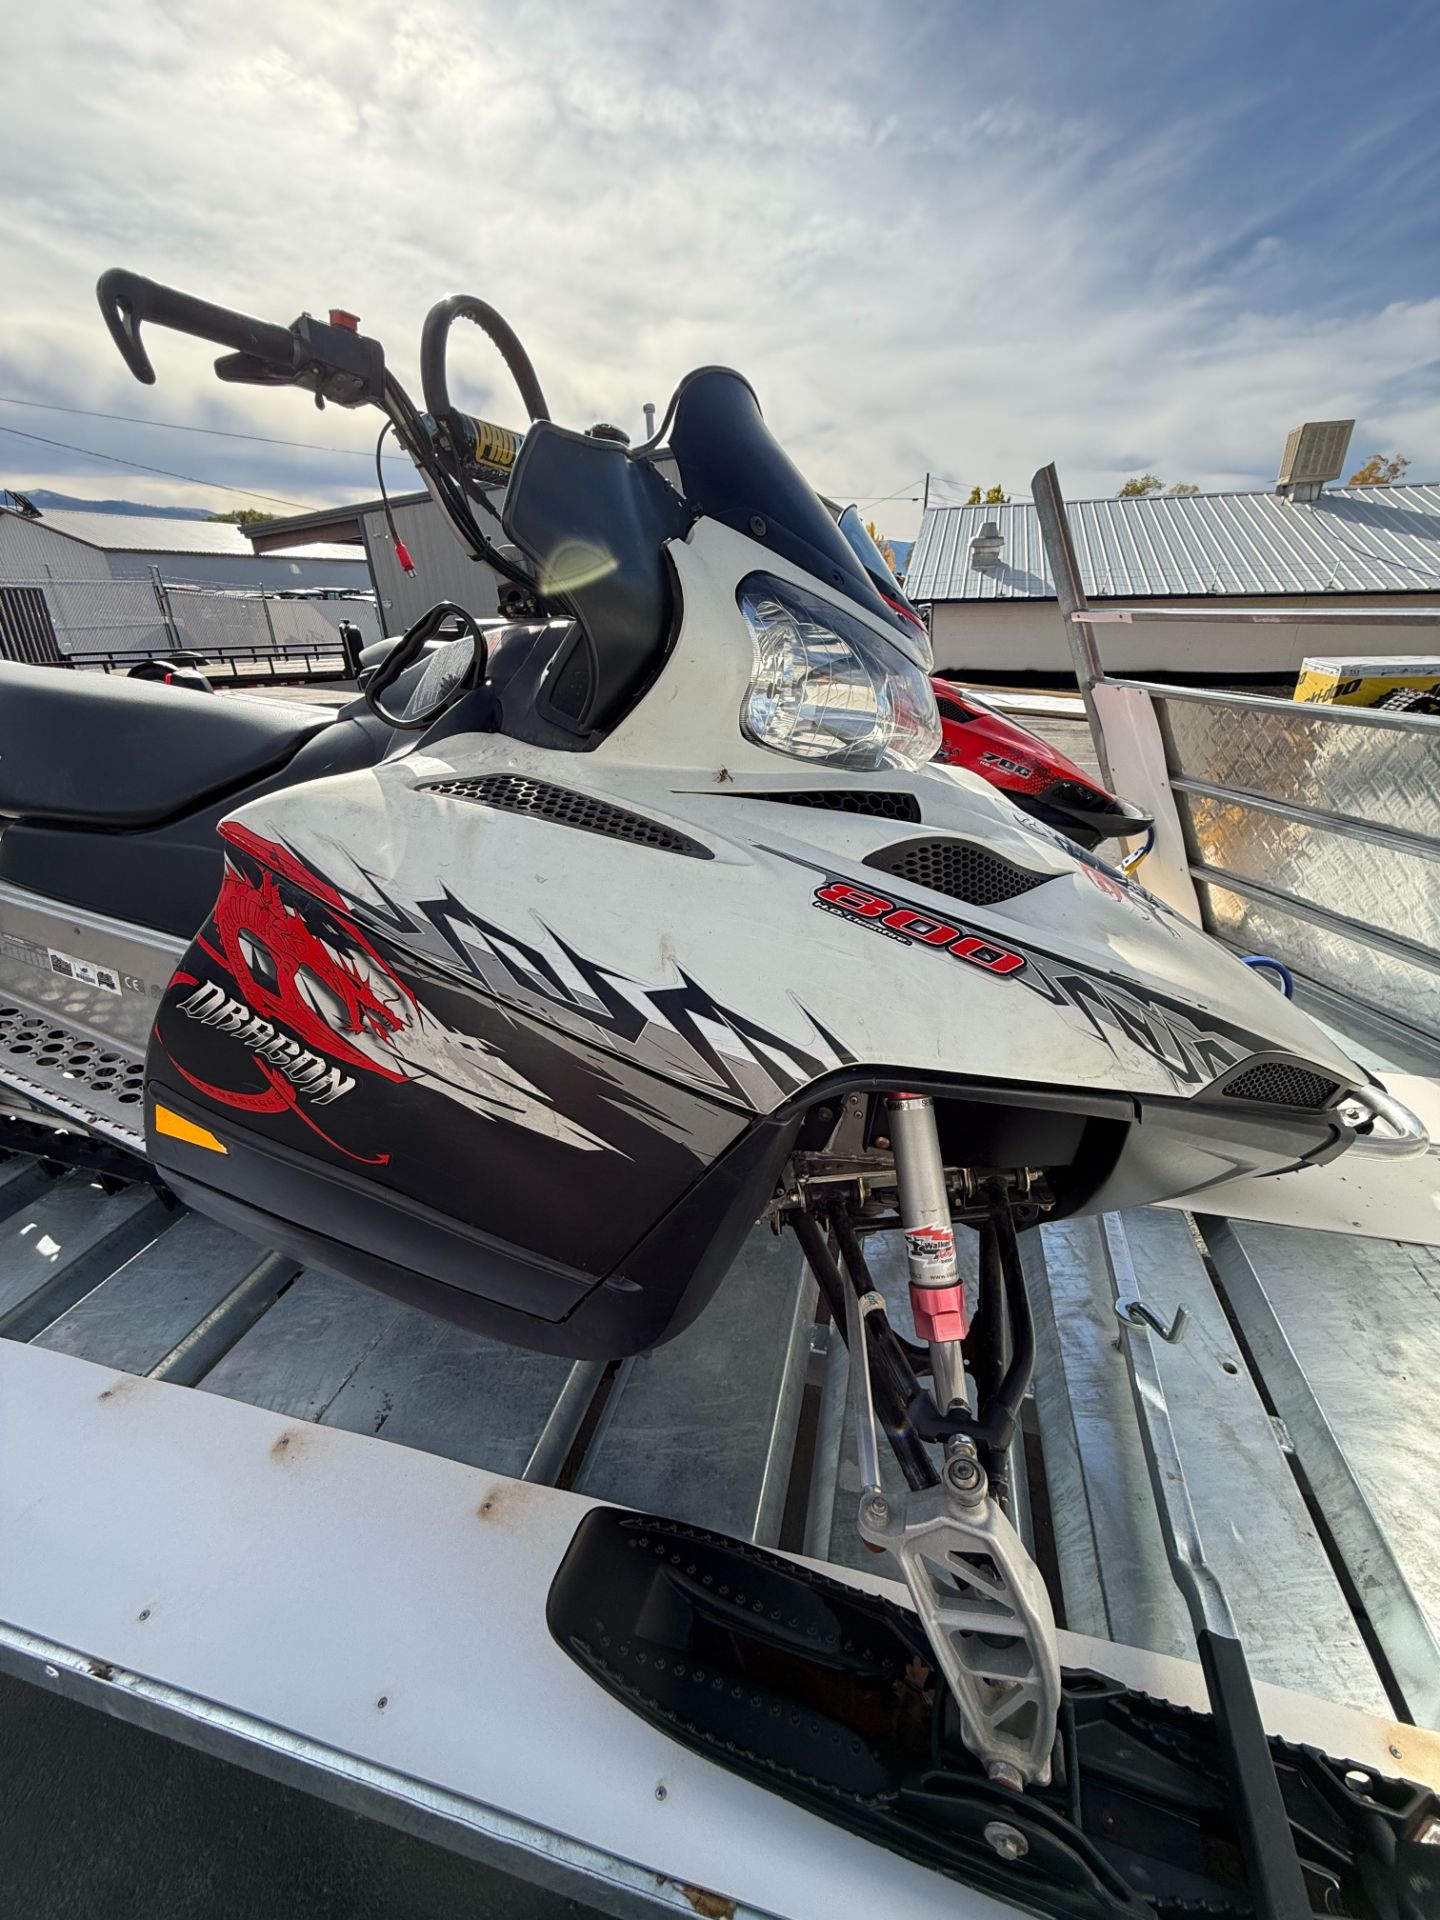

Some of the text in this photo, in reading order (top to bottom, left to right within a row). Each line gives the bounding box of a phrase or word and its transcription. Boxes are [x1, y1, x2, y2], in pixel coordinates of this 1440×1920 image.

[978, 751, 1033, 779] 700
[814, 901, 844, 918] H.O.
[816, 882, 1026, 975] 800
[175, 979, 356, 1106] DRAGON
